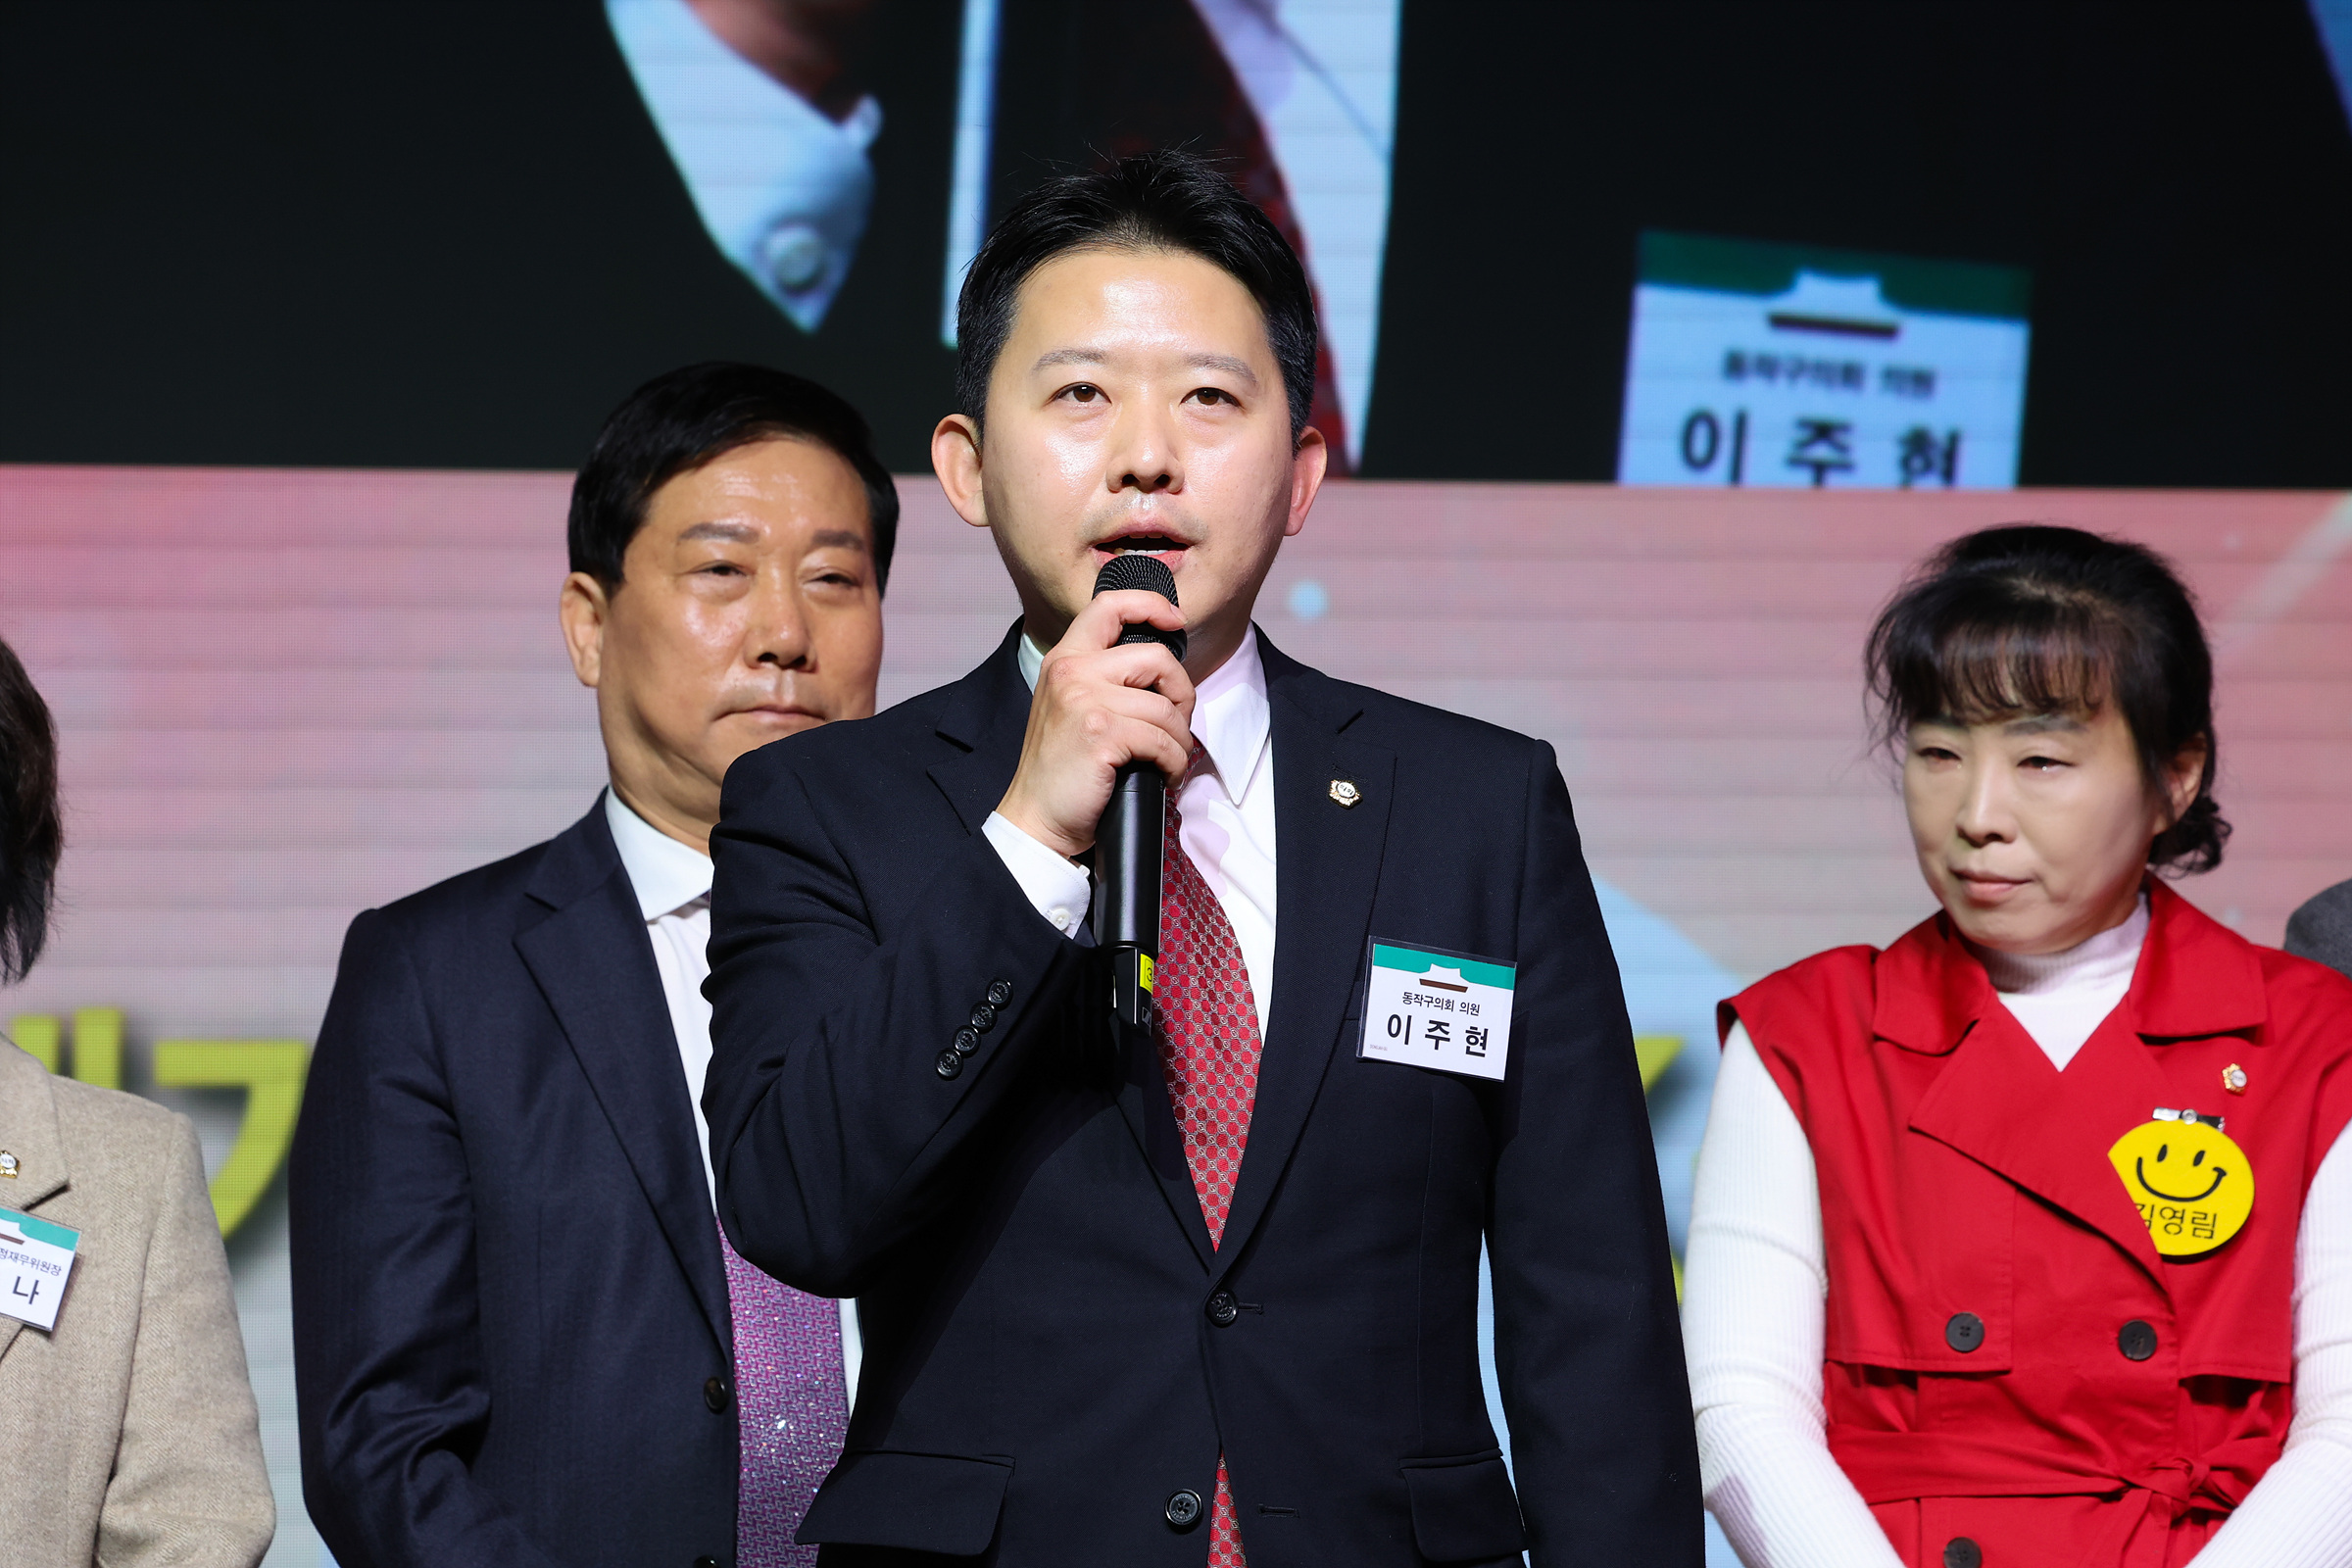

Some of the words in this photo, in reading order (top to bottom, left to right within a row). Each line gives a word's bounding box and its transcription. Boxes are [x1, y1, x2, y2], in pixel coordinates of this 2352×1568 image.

[1401, 991, 1455, 1012] 동작구의회
[1458, 1002, 1481, 1017] 의원
[12, 1275, 40, 1305] 나
